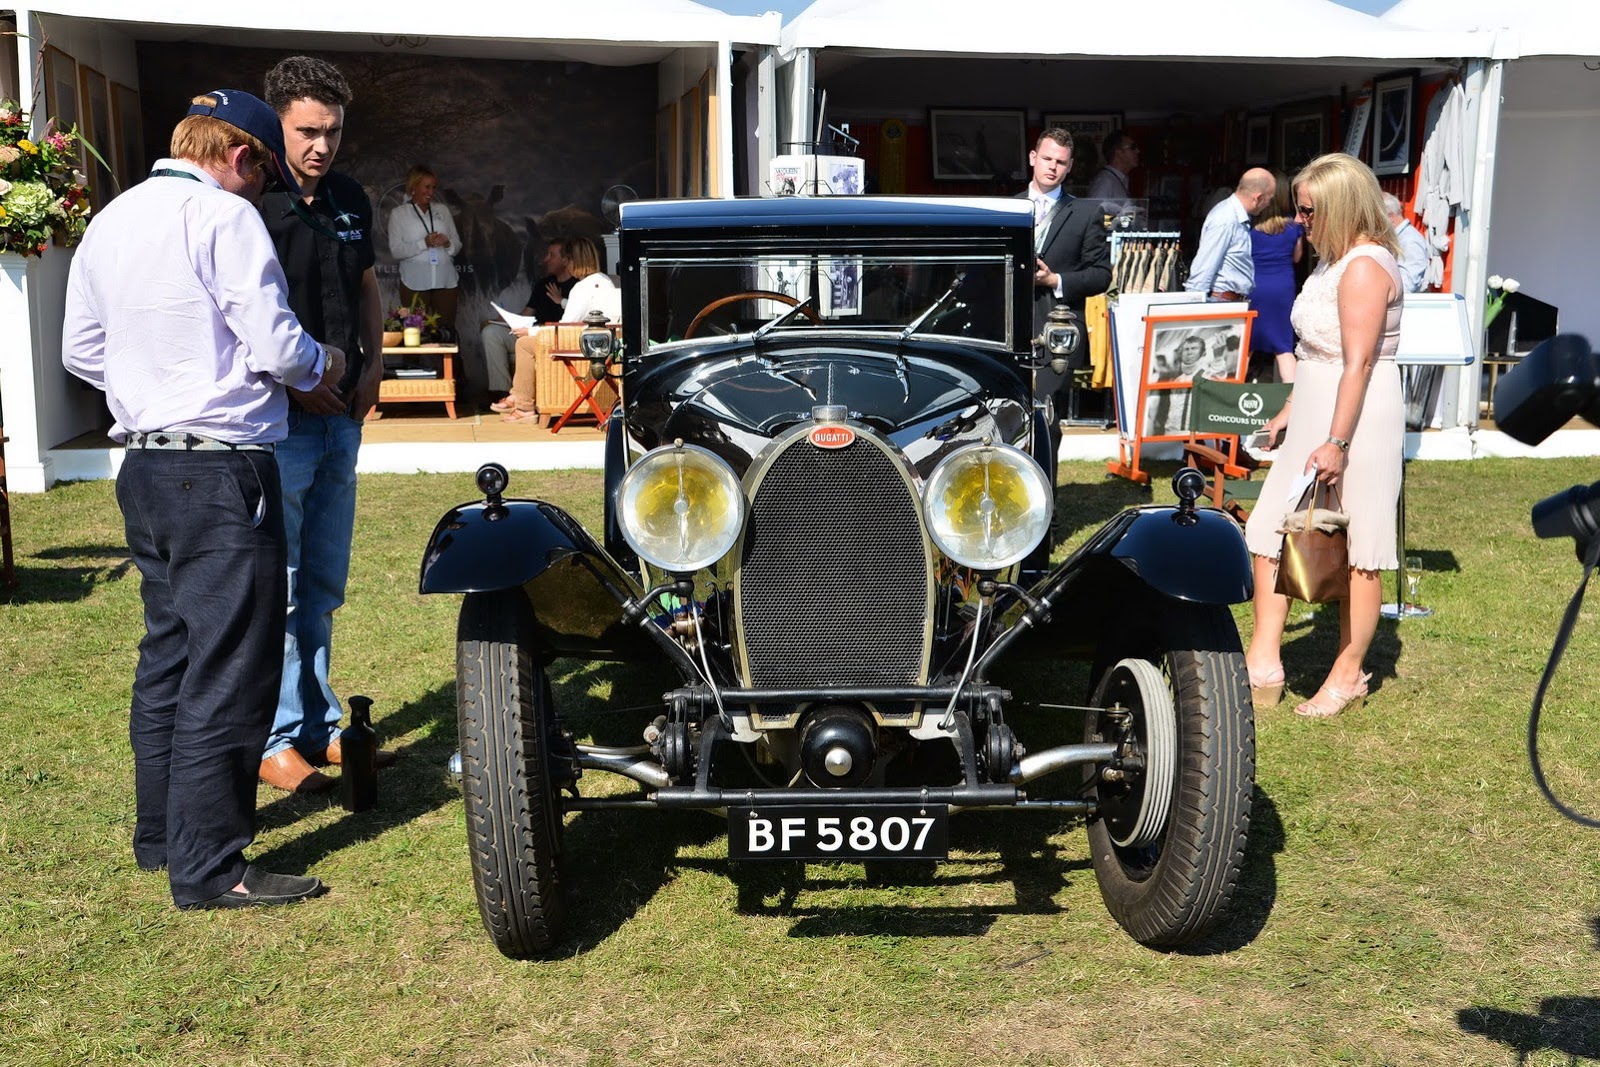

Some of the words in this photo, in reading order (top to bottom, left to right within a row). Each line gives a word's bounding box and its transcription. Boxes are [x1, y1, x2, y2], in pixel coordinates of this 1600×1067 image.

[1208, 413, 1249, 425] CONCOURS
[815, 433, 849, 442] BUGATTI
[748, 818, 806, 852] BF
[816, 816, 936, 852] 5807
